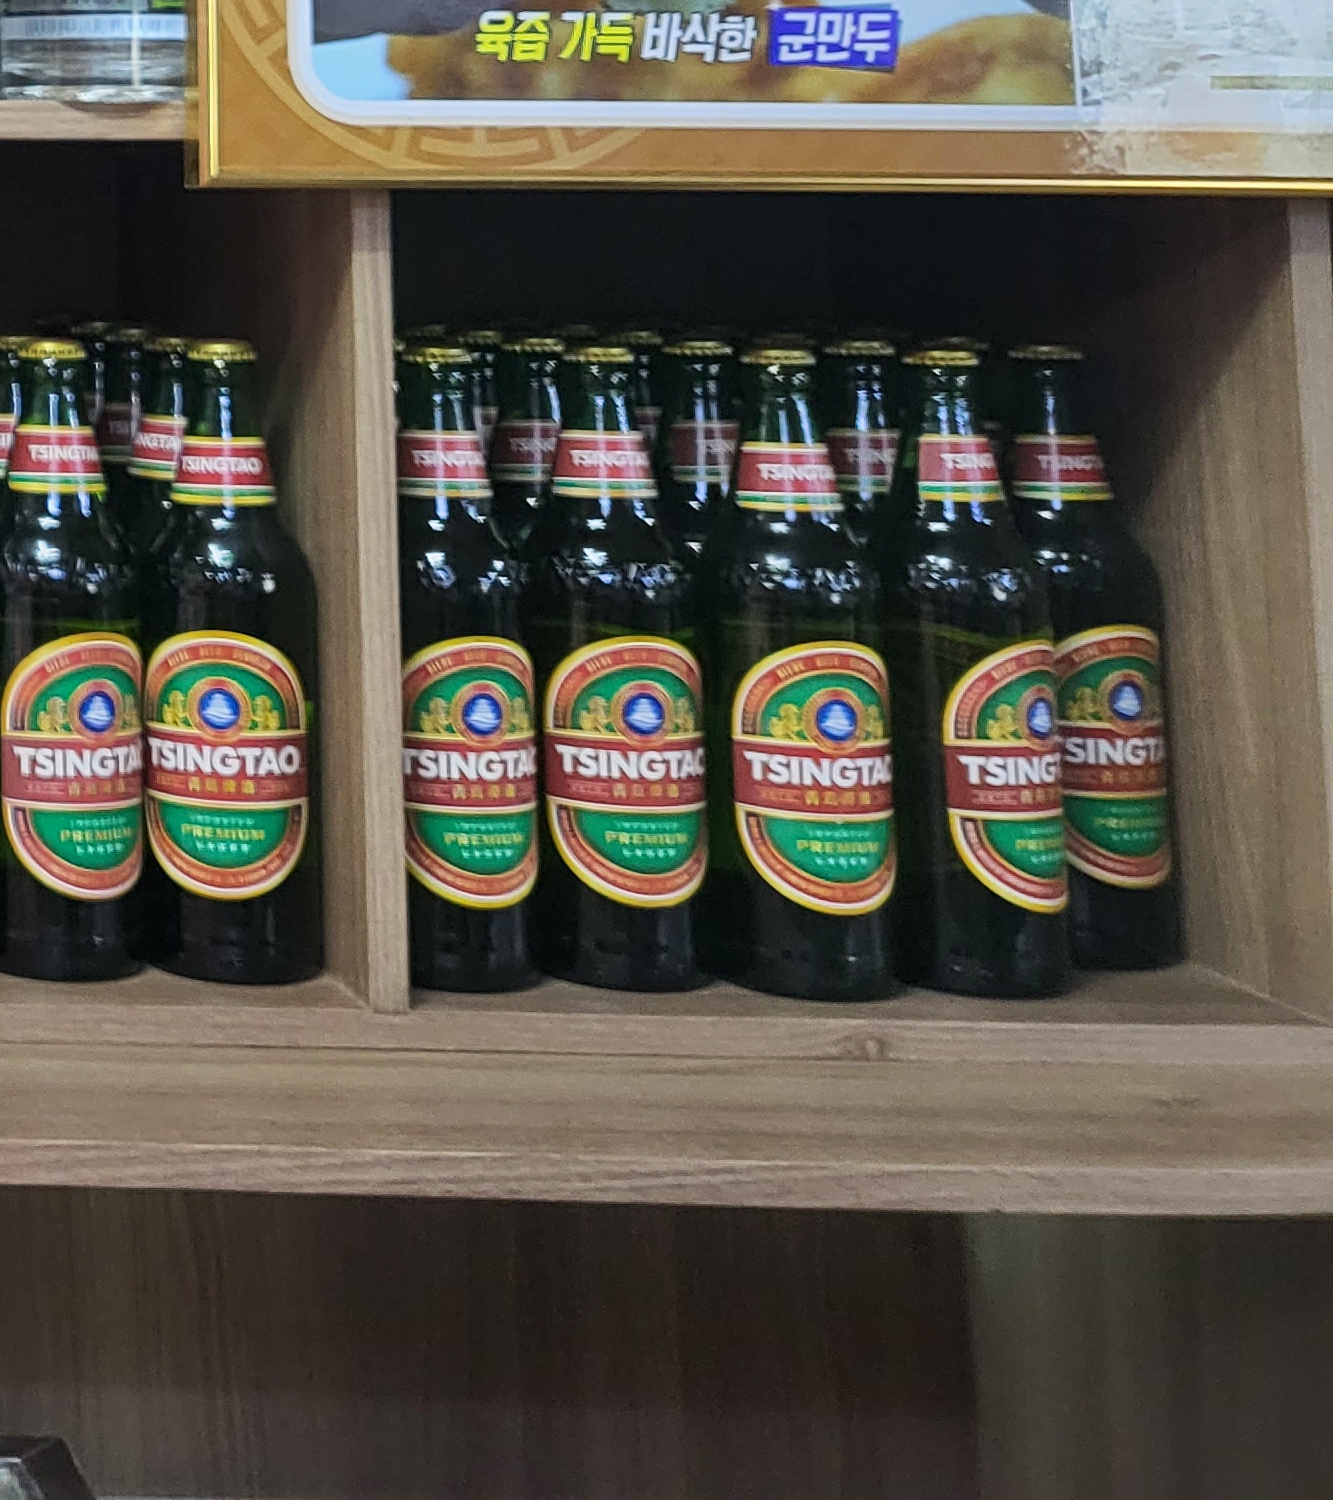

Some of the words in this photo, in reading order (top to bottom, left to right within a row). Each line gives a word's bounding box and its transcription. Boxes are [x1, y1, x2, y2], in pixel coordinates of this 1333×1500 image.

[475, 9, 551, 62] 육즙
[559, 9, 633, 61] 가득
[640, 11, 758, 63] 바삭한
[777, 12, 893, 63] 군만두
[179, 455, 261, 476] TSINGTAO
[146, 737, 301, 777] TSINGTAO
[181, 823, 267, 842] PREMIUM
